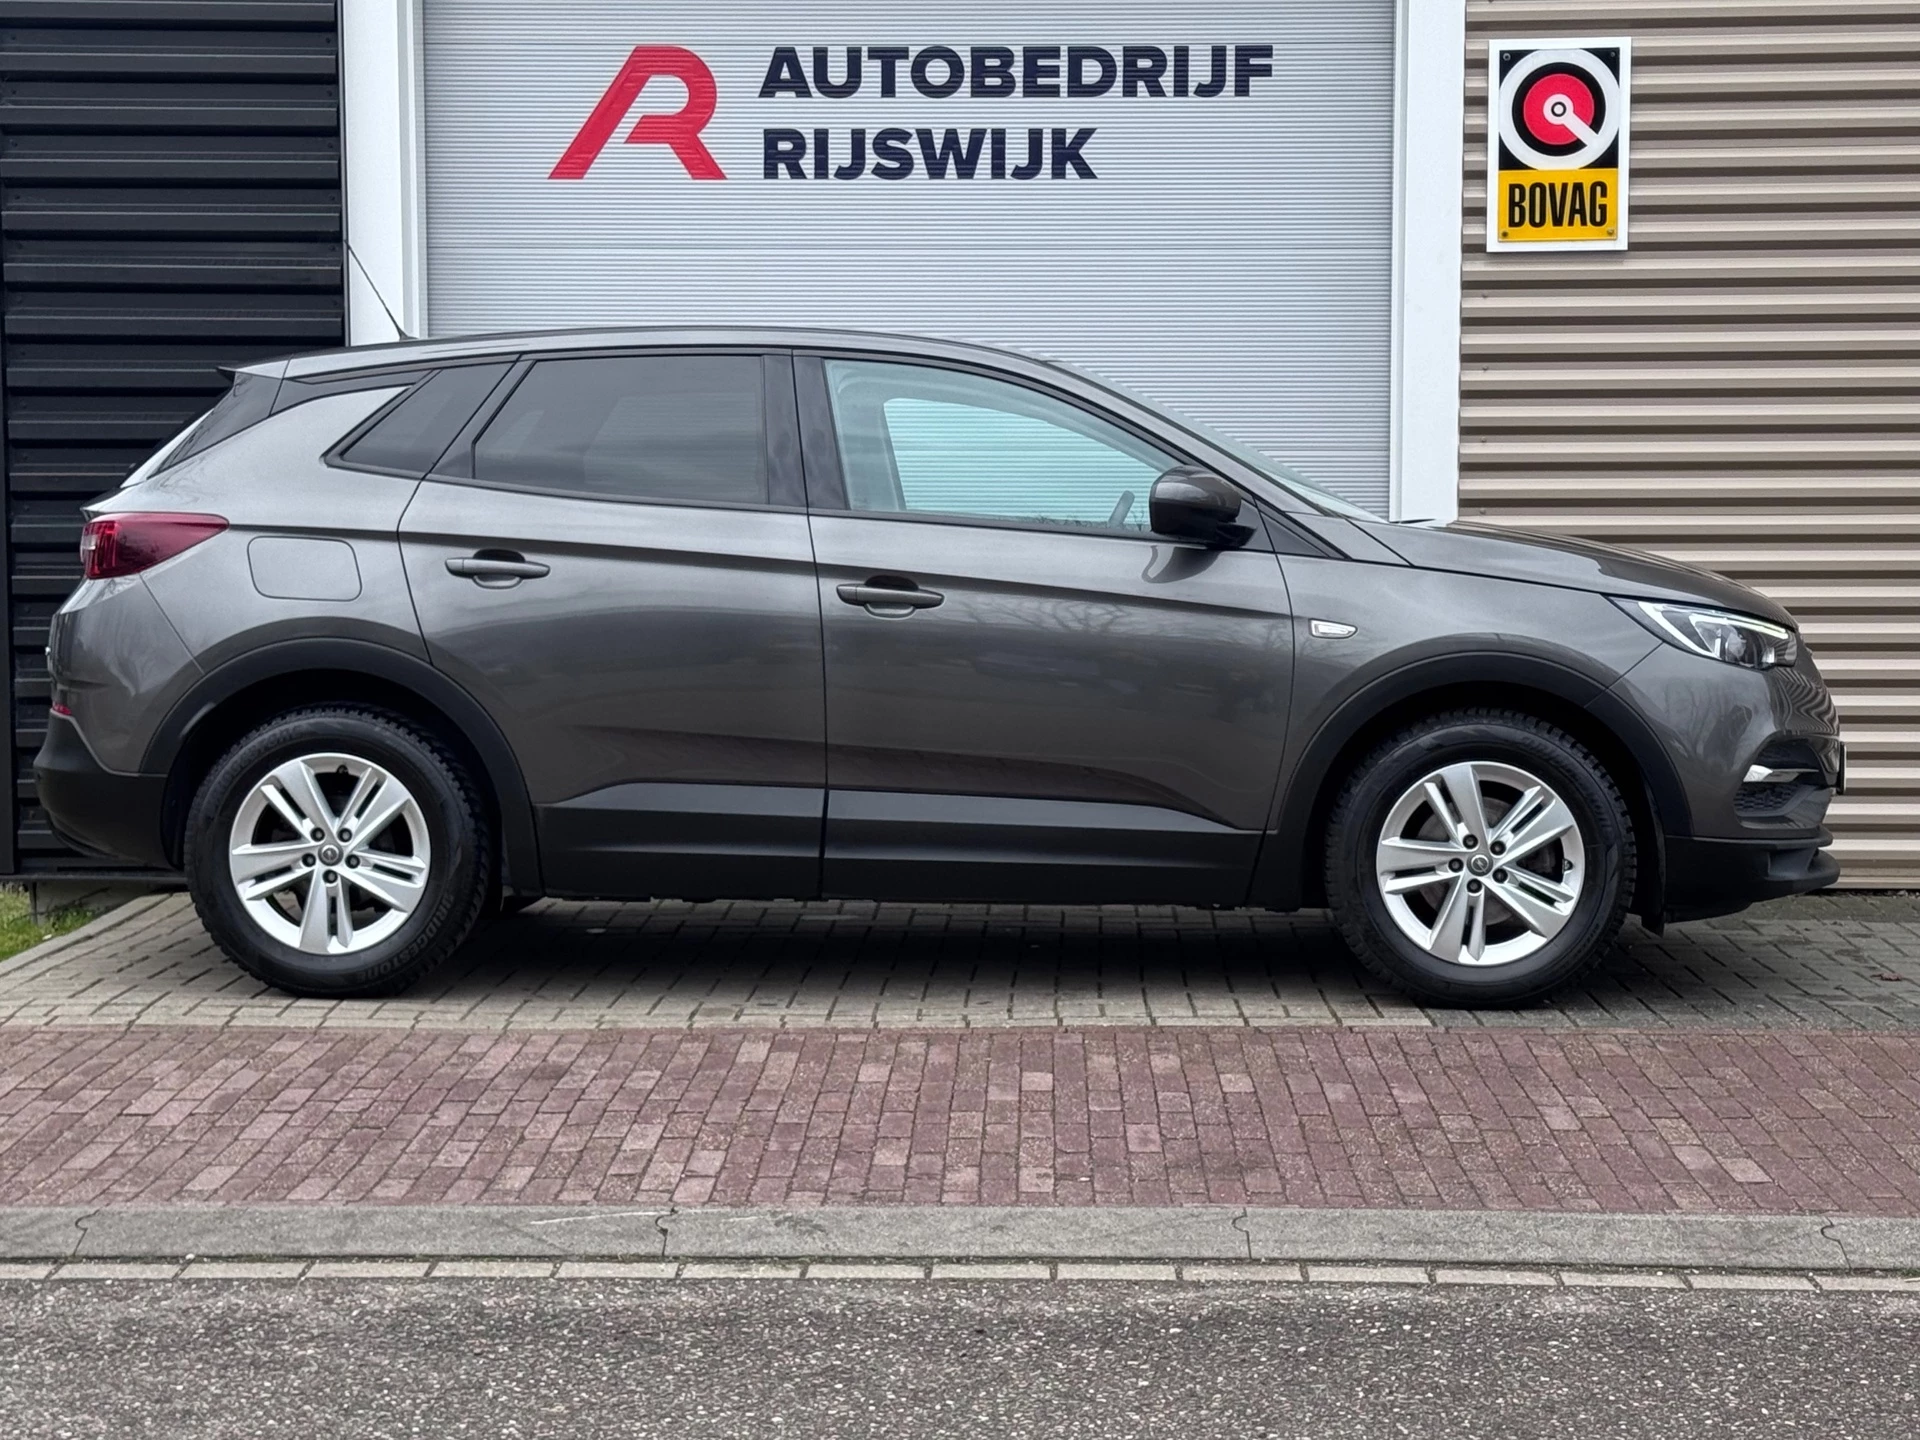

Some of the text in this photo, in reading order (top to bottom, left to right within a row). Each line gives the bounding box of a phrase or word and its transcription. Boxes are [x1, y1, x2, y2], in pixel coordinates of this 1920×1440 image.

[759, 46, 1274, 98] AUTOBEDRIJF
[764, 128, 1098, 180] RIJSWIJK
[1508, 181, 1608, 228] BOVAG
[356, 893, 455, 984] BRIDGESTONE
